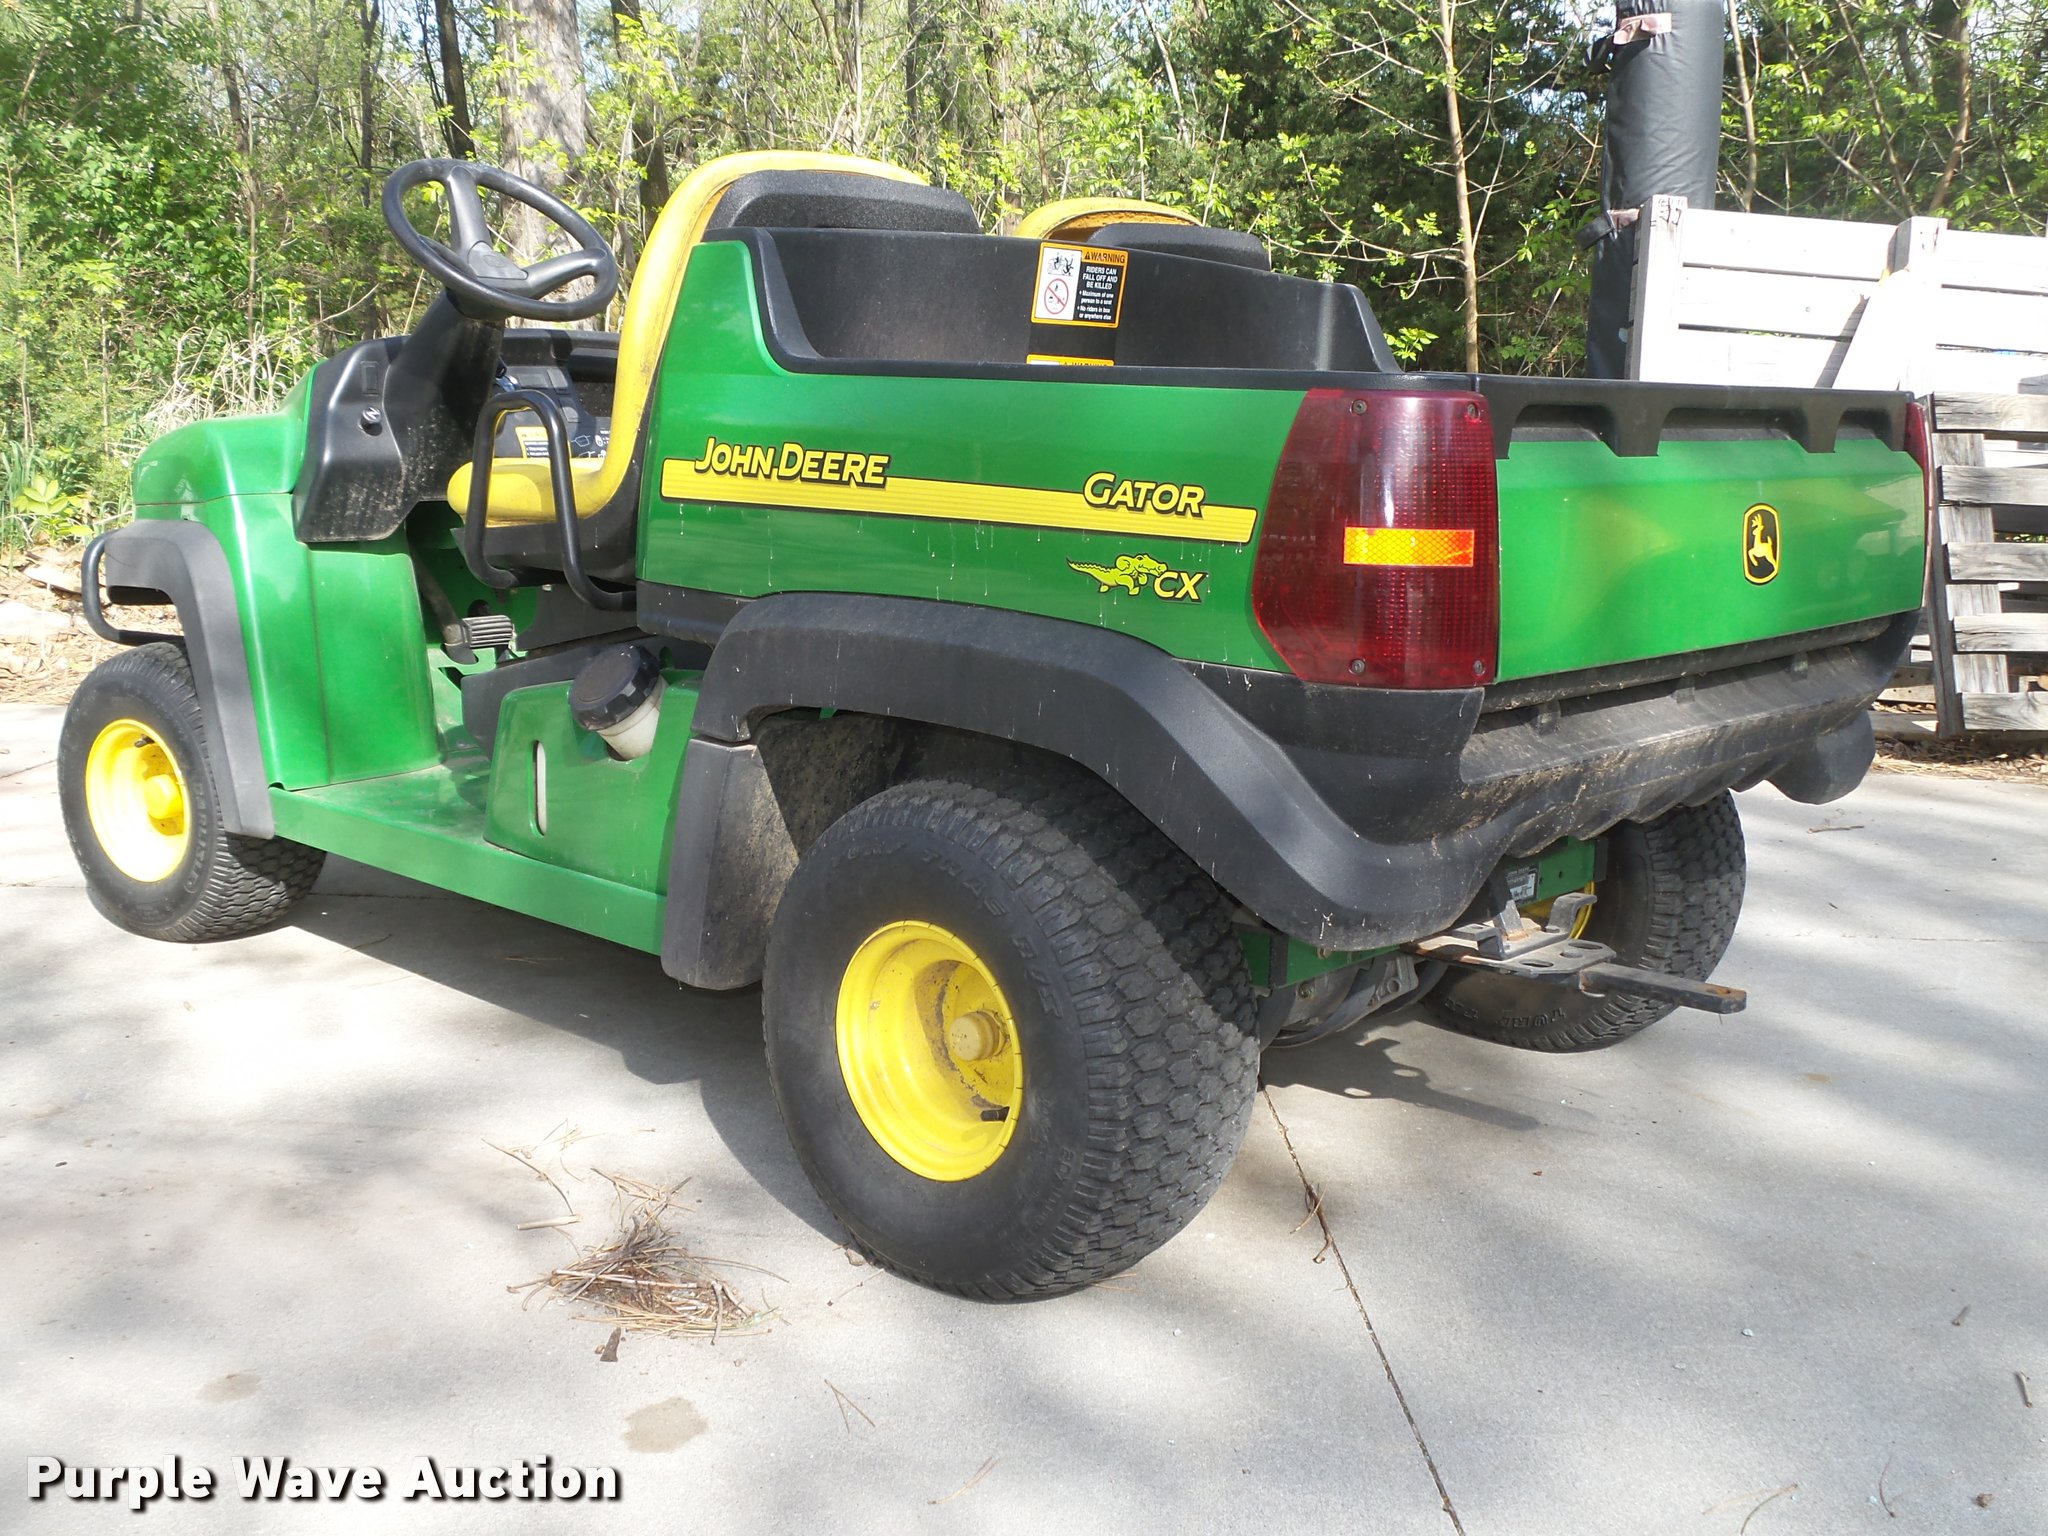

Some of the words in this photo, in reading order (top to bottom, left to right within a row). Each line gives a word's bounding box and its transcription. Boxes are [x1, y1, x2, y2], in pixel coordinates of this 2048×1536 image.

[1091, 251, 1125, 263] WARNING
[1086, 266, 1105, 274] RIDERS
[1105, 267, 1117, 275] CAN
[1082, 273, 1095, 281] FALL
[1107, 275, 1118, 283] AND
[1094, 282, 1113, 290] KILLED
[694, 436, 776, 478] JOHN
[776, 441, 891, 488] DEERE
[1083, 471, 1206, 518] GATOR
[1153, 571, 1206, 602] CX
